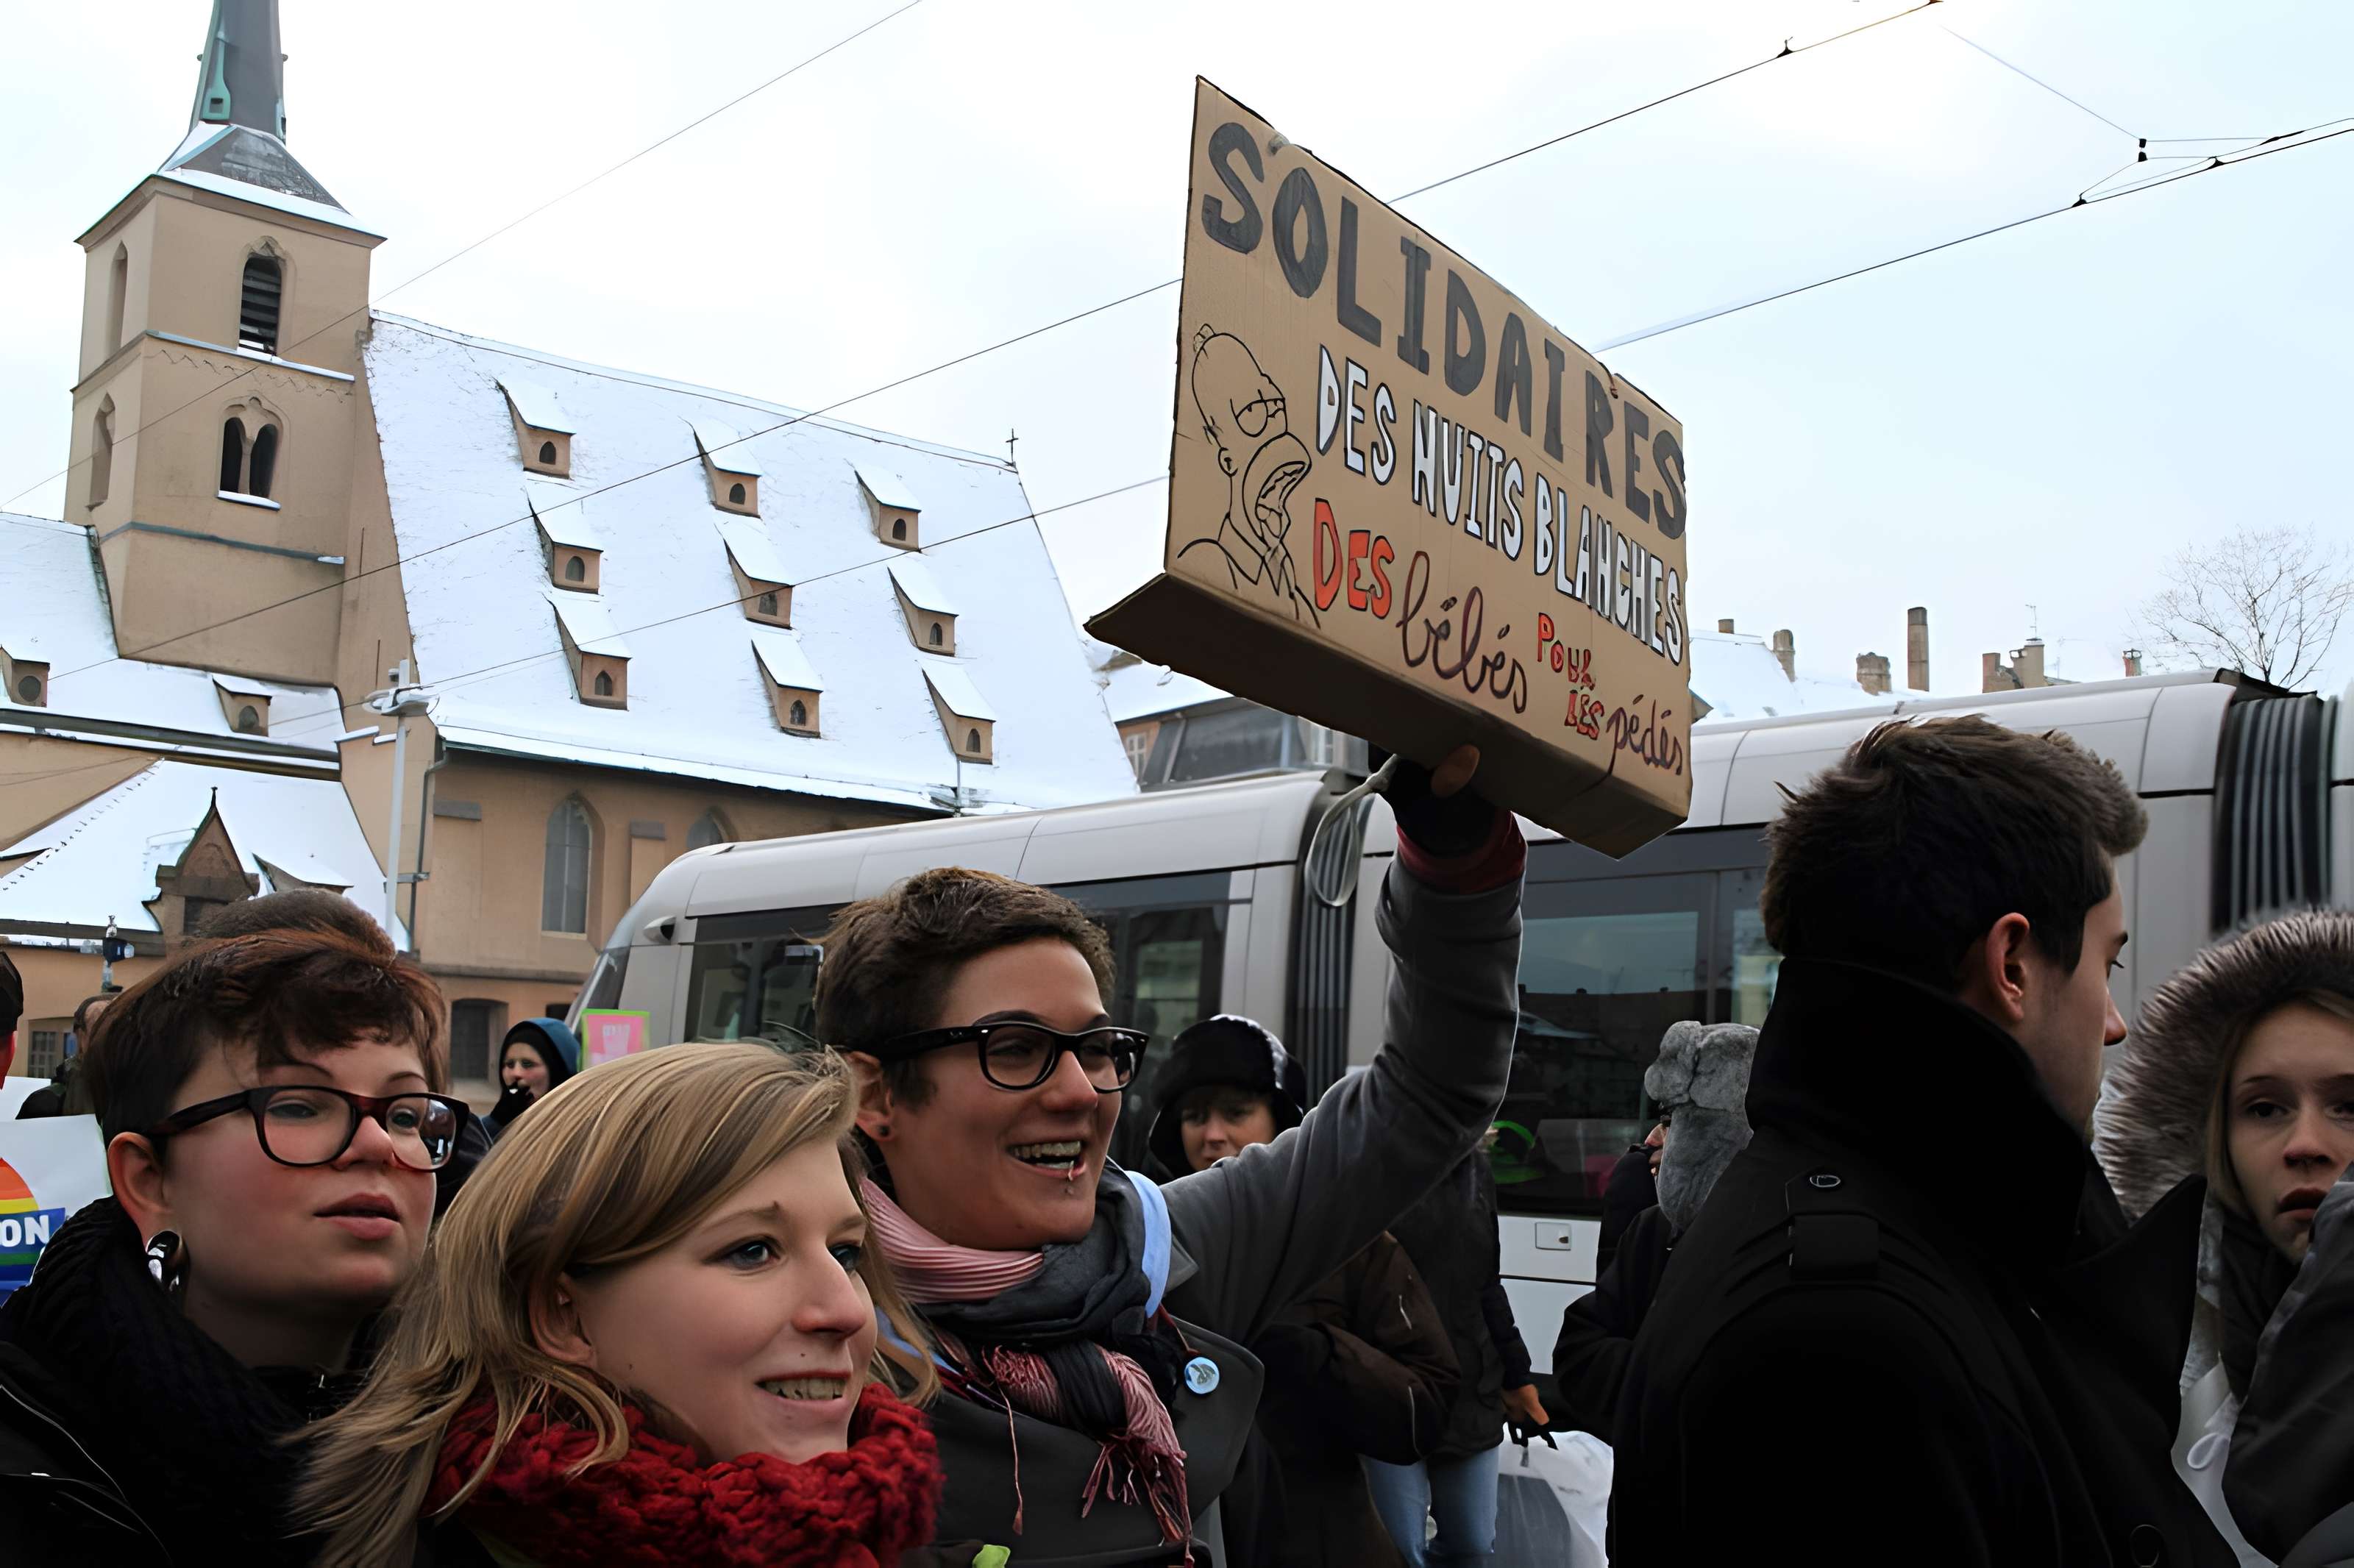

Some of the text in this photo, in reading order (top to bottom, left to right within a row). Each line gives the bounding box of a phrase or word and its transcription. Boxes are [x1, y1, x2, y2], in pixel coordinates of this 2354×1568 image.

[1201, 121, 1687, 540] SOLIDAIRES
[1312, 497, 1528, 714] DES bébés
[1316, 343, 1684, 666] DES NUITS BLANCHES
[1564, 689, 1683, 776] LES pédés
